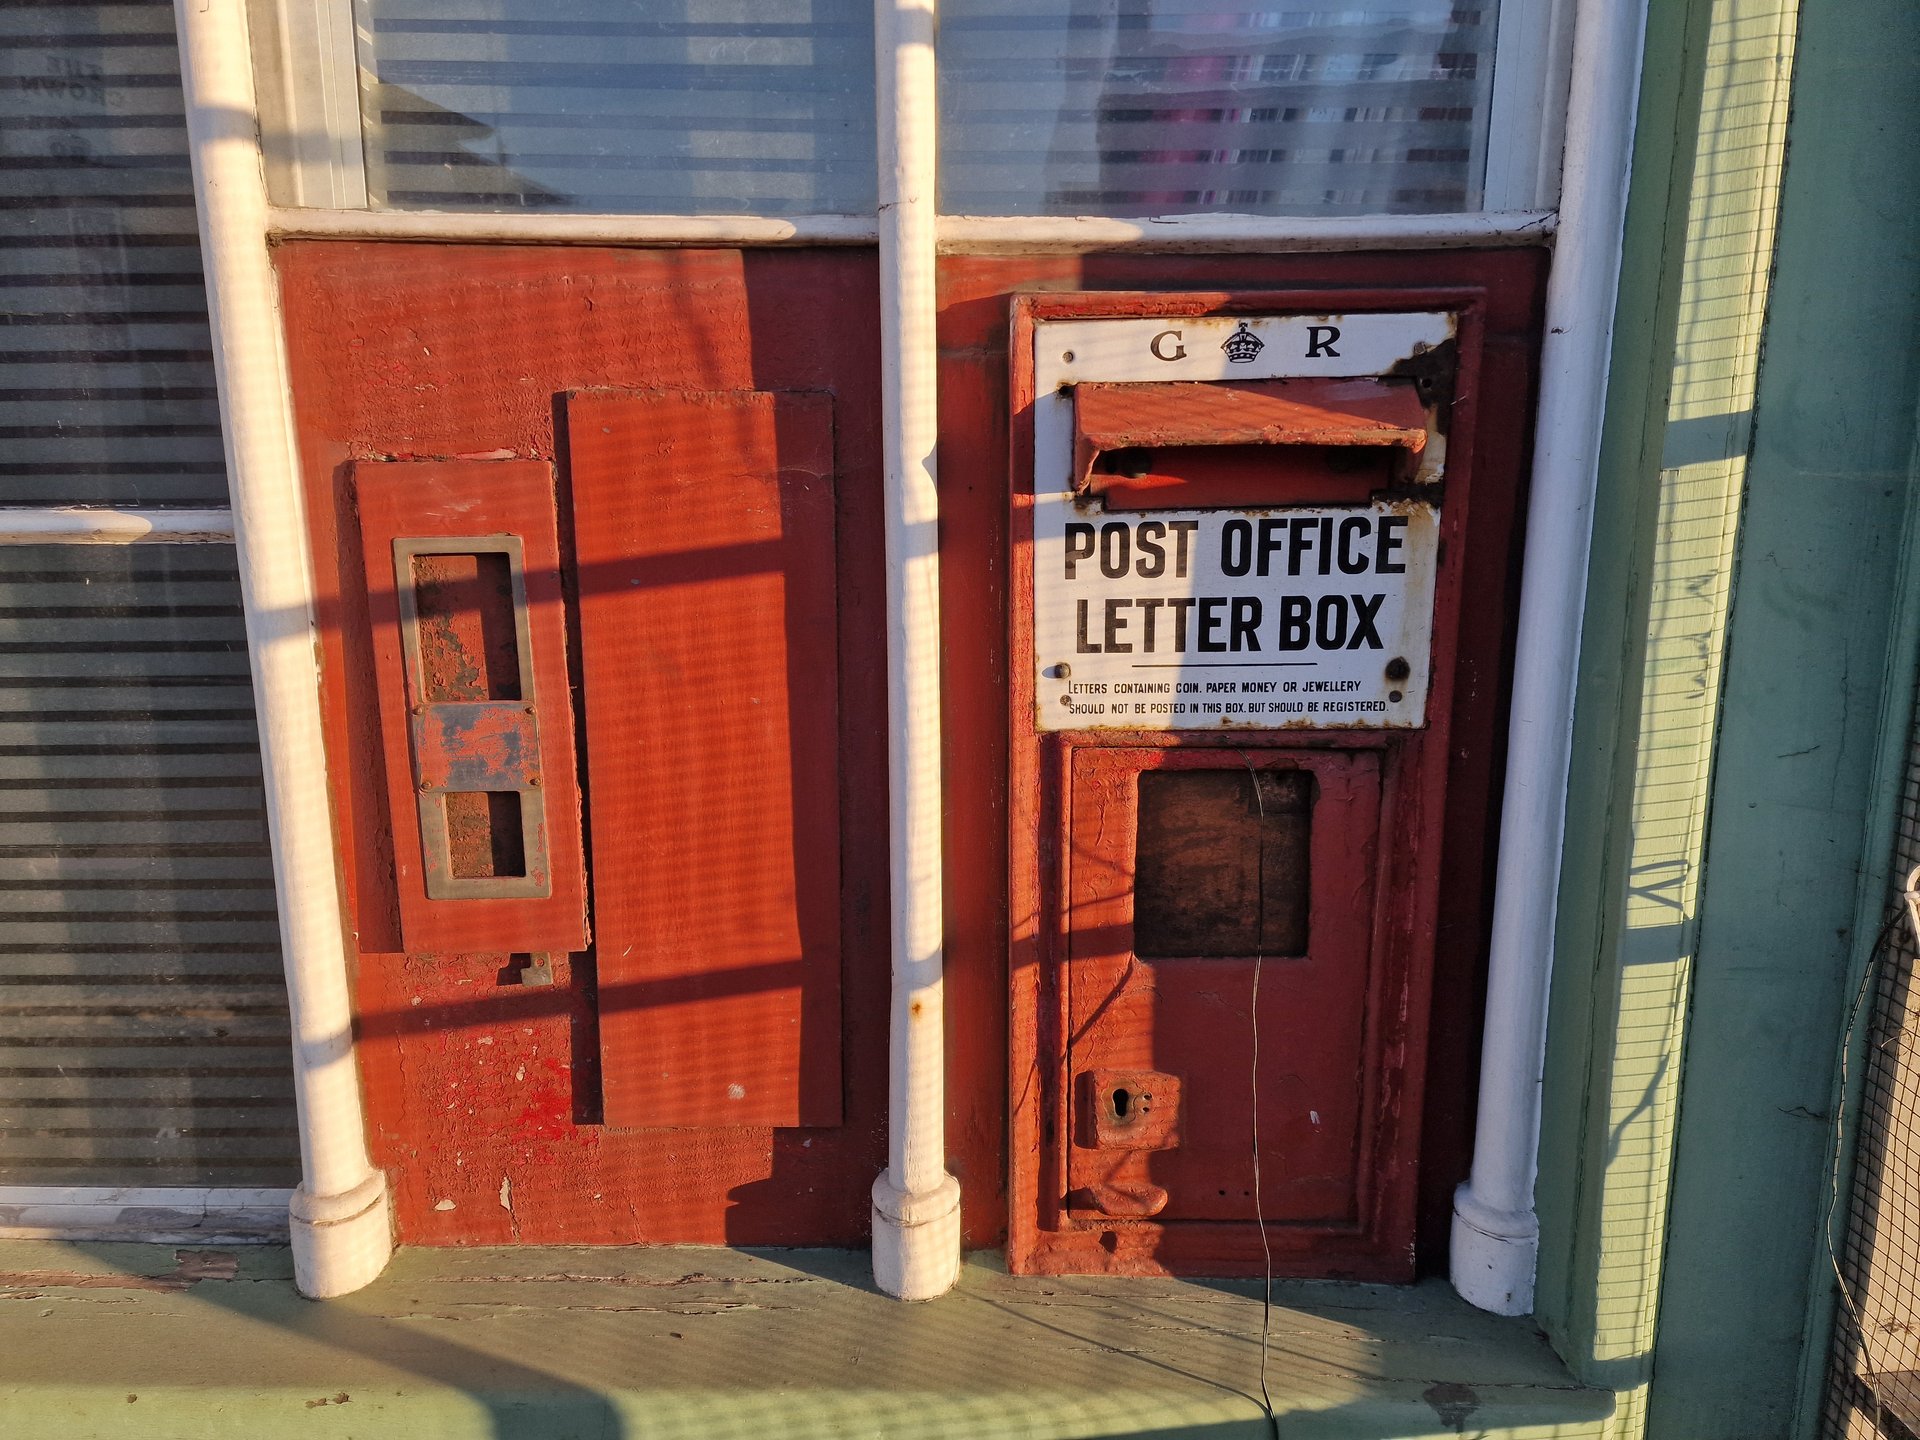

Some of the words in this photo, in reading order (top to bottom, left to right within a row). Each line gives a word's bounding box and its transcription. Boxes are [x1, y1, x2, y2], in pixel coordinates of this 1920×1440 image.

[1150, 330, 1188, 361] G
[1305, 326, 1340, 358] R
[1064, 520, 1199, 579] POST
[1220, 516, 1409, 577] OFFICE
[1076, 597, 1263, 654] LETTER
[1279, 593, 1387, 651] BOX
[1068, 681, 1108, 694] LETTERS
[1114, 683, 1170, 694] CONTAINING
[1206, 682, 1236, 693] PAPER
[1241, 682, 1277, 693] MONEY
[1282, 682, 1297, 692] OR
[1302, 681, 1362, 692] JEWELLERY
[1069, 704, 1105, 714] SHOULD
[1111, 703, 1129, 714] NOT
[1134, 703, 1147, 713] BE
[1150, 703, 1186, 714] POSTED
[1189, 703, 1199, 713] IN
[1202, 702, 1222, 713] THIS
[1249, 702, 1266, 713] BUT
[1268, 702, 1303, 712] SHOULD
[1307, 702, 1319, 712] BE
[1322, 701, 1389, 712] REGISTERED.
